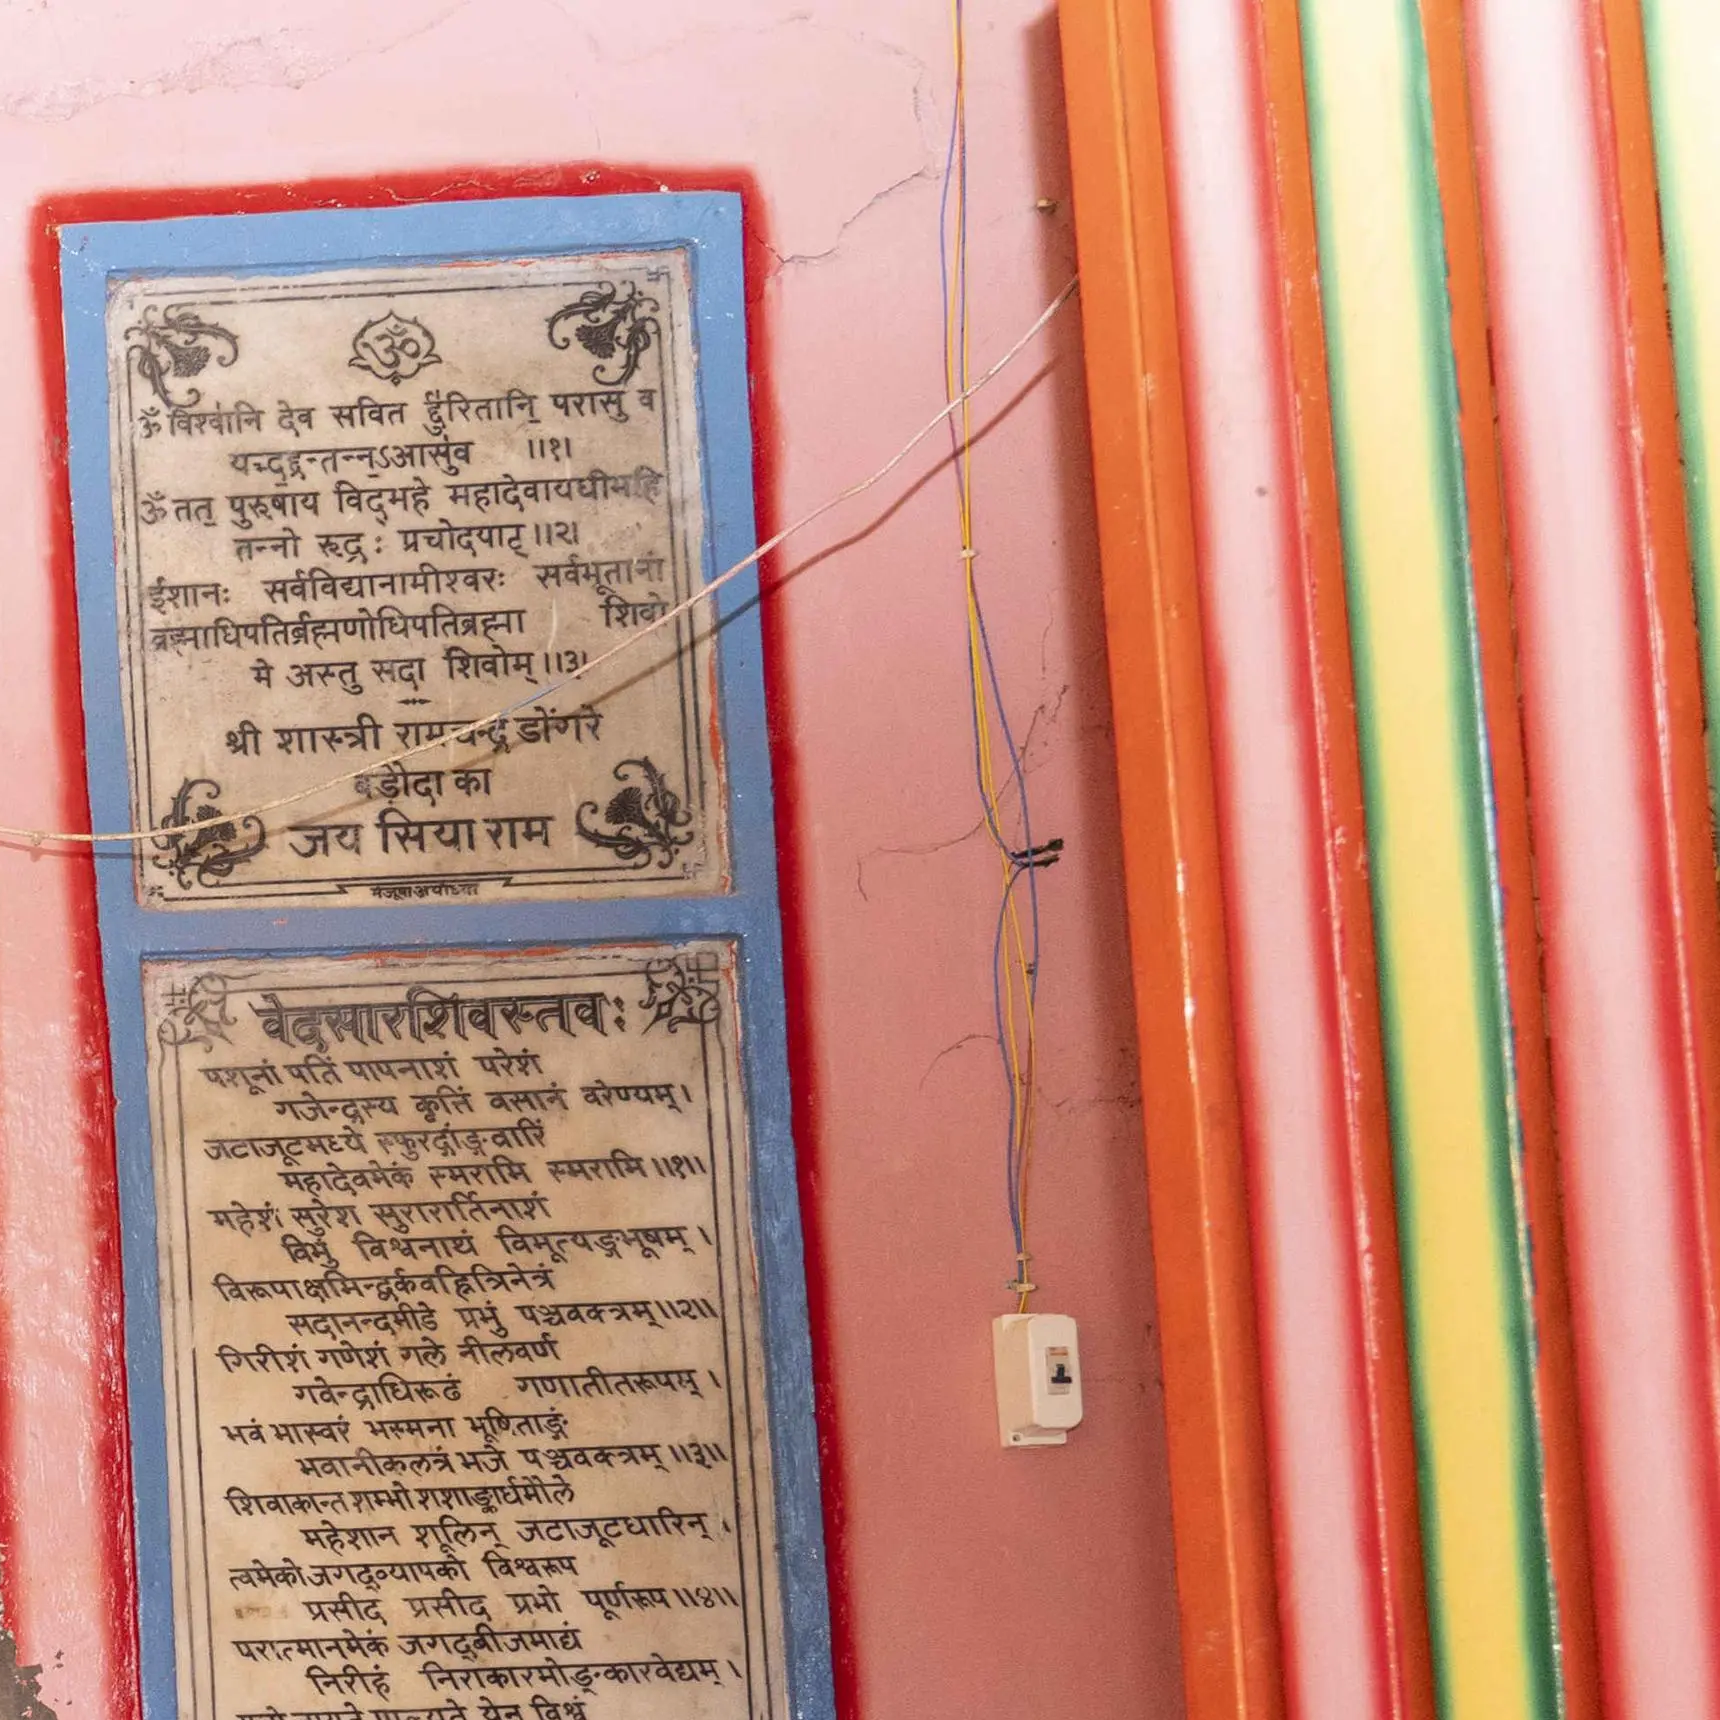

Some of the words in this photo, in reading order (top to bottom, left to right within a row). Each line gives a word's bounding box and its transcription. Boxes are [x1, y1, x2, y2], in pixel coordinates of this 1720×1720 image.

[278, 400, 316, 437] देव
[328, 396, 408, 428] सवित
[233, 527, 302, 562] तन्नो
[250, 658, 274, 689] मे
[286, 661, 363, 695] अस्तु
[370, 658, 426, 691] सदा
[442, 645, 538, 684] शिवोम्
[226, 720, 262, 756] श्री
[273, 712, 383, 754] शास्त्री
[514, 701, 603, 743] डोंगरे
[451, 768, 492, 796] का
[286, 821, 363, 858] जय
[375, 808, 476, 854] सिया
[483, 816, 555, 850] राम
[254, 987, 628, 1049] वेदसारशिवस्तवः
[198, 1065, 282, 1095] पशूनां
[283, 1054, 342, 1084] पतिं
[344, 1057, 459, 1081] पापनाशं
[472, 1047, 543, 1076] परेशं
[351, 1231, 478, 1261] विश्वनाथं
[215, 1343, 310, 1373] गिरीशं
[315, 1341, 391, 1368] गणेशं
[399, 1336, 446, 1367] गले
[220, 1424, 266, 1445] भवं
[269, 1421, 350, 1444] भास्वरं
[364, 1417, 455, 1439] भस्मना
[224, 1486, 348, 1516] शिवाकान्त
[349, 1481, 414, 1513] शम्भो
[299, 1520, 399, 1554] महेशान
[481, 1550, 578, 1579] विश्वरूप
[302, 1593, 387, 1626] प्रसीद
[405, 1587, 492, 1621] प्रसीद
[509, 1585, 562, 1614] प्रभो
